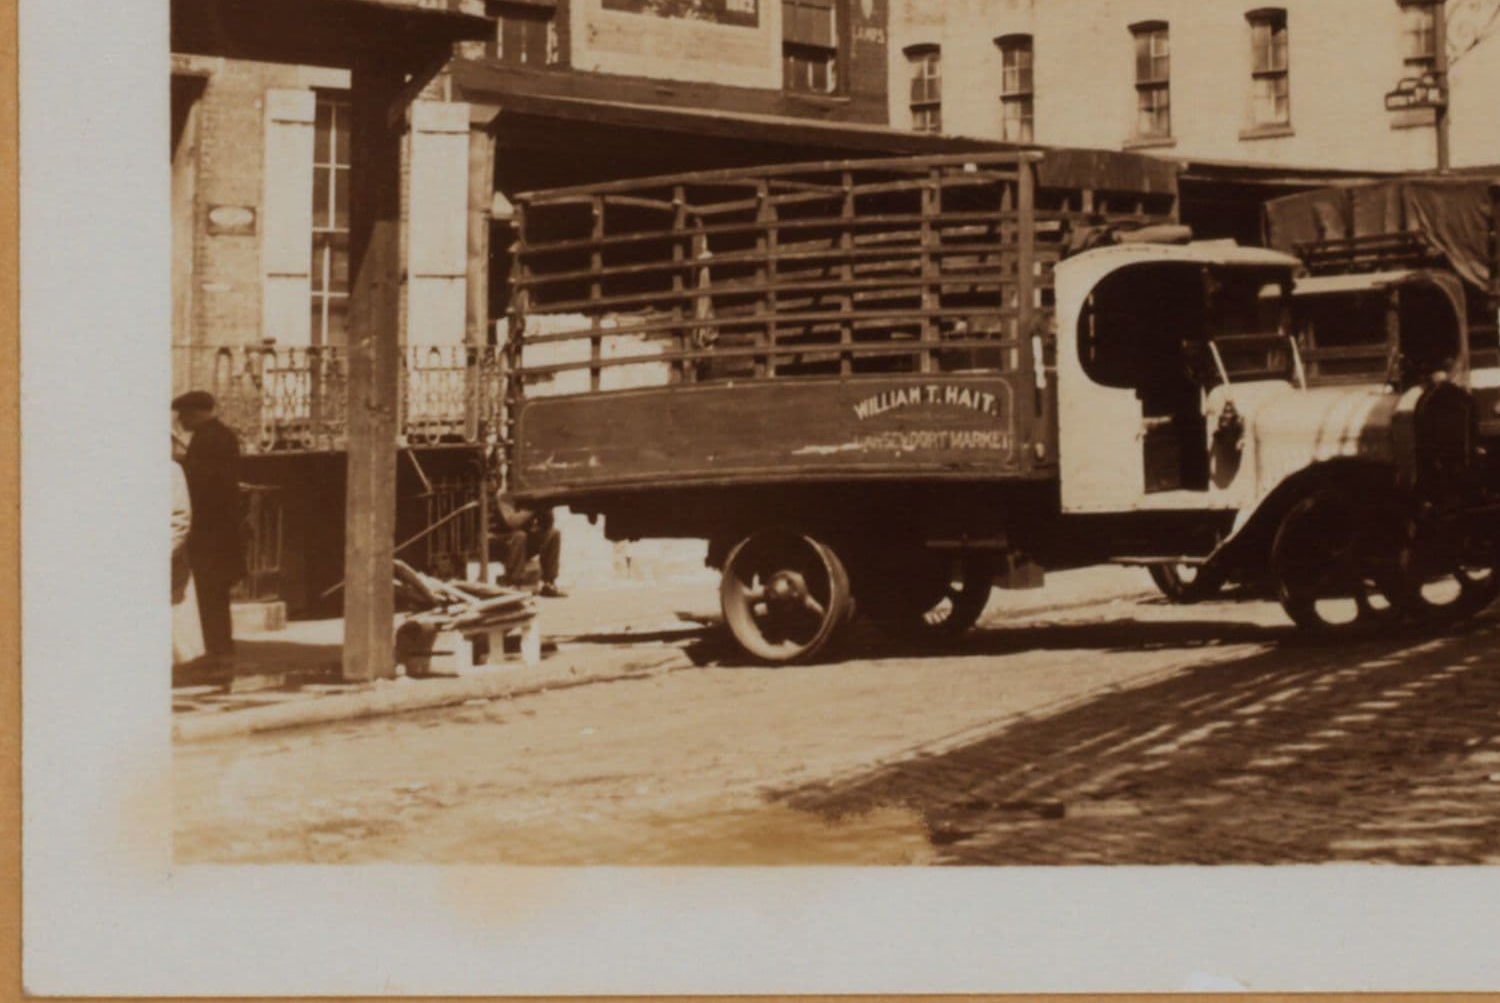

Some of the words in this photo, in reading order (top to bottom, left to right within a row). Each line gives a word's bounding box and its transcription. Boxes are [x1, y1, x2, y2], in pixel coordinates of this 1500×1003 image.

[854, 385, 921, 420] WILLIAM
[925, 385, 943, 404] T.
[945, 385, 998, 416] HAIT.
[950, 430, 1009, 449] MARKET
